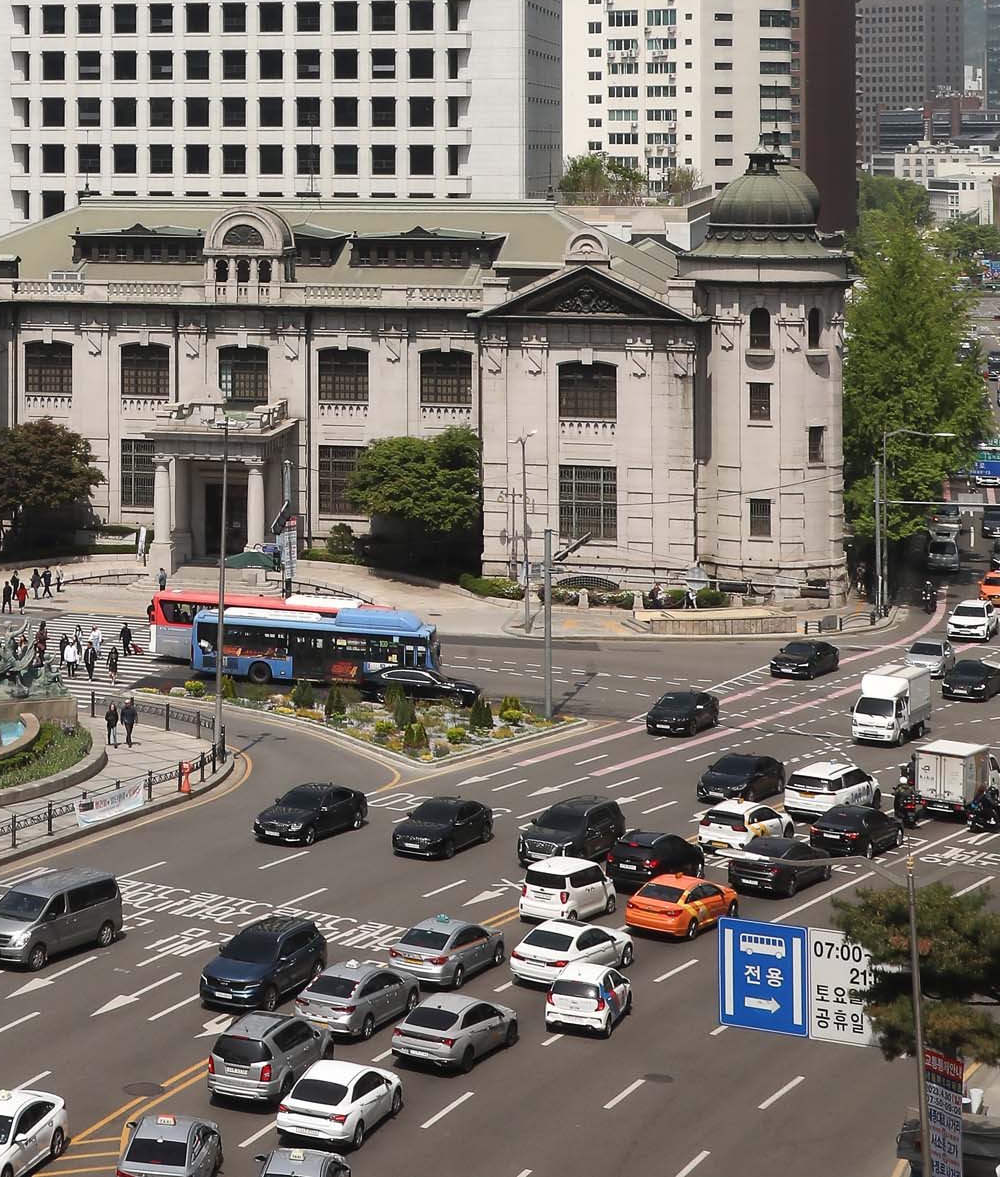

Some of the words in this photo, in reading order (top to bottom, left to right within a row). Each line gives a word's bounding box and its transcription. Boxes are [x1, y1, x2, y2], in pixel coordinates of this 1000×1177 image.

[744, 965, 784, 988] 전용
[849, 968, 878, 985] 21:
[815, 1008, 864, 1034] 공휴일
